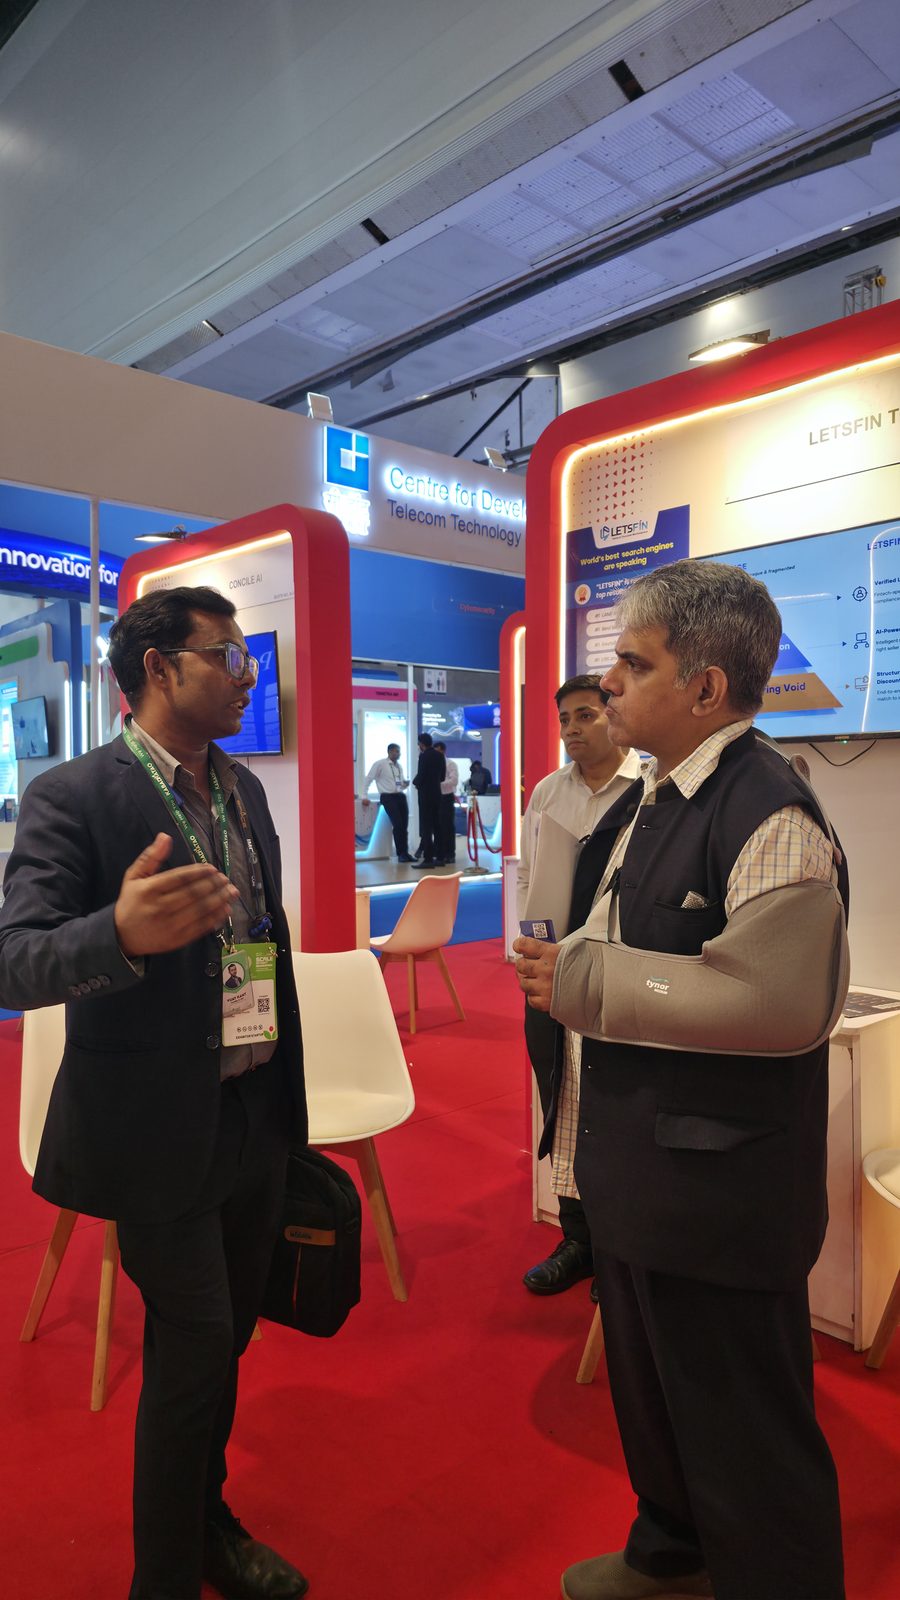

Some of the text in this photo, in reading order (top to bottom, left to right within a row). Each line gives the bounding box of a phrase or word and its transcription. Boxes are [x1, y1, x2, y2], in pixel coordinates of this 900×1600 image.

[809, 412, 882, 446] LETSFIN
[390, 467, 449, 501] Centre
[455, 483, 476, 507] for
[387, 499, 446, 529] Telecom
[451, 513, 522, 547] Technology
[605, 552, 620, 562] best
[621, 547, 645, 558] search
[645, 542, 674, 553] engines
[603, 557, 648, 571] are speaking
[98, 563, 119, 586] for
[229, 574, 263, 590] CONCILE AI
[874, 577, 897, 586] Verified
[783, 682, 806, 692] Void
[646, 979, 670, 990] tynor
